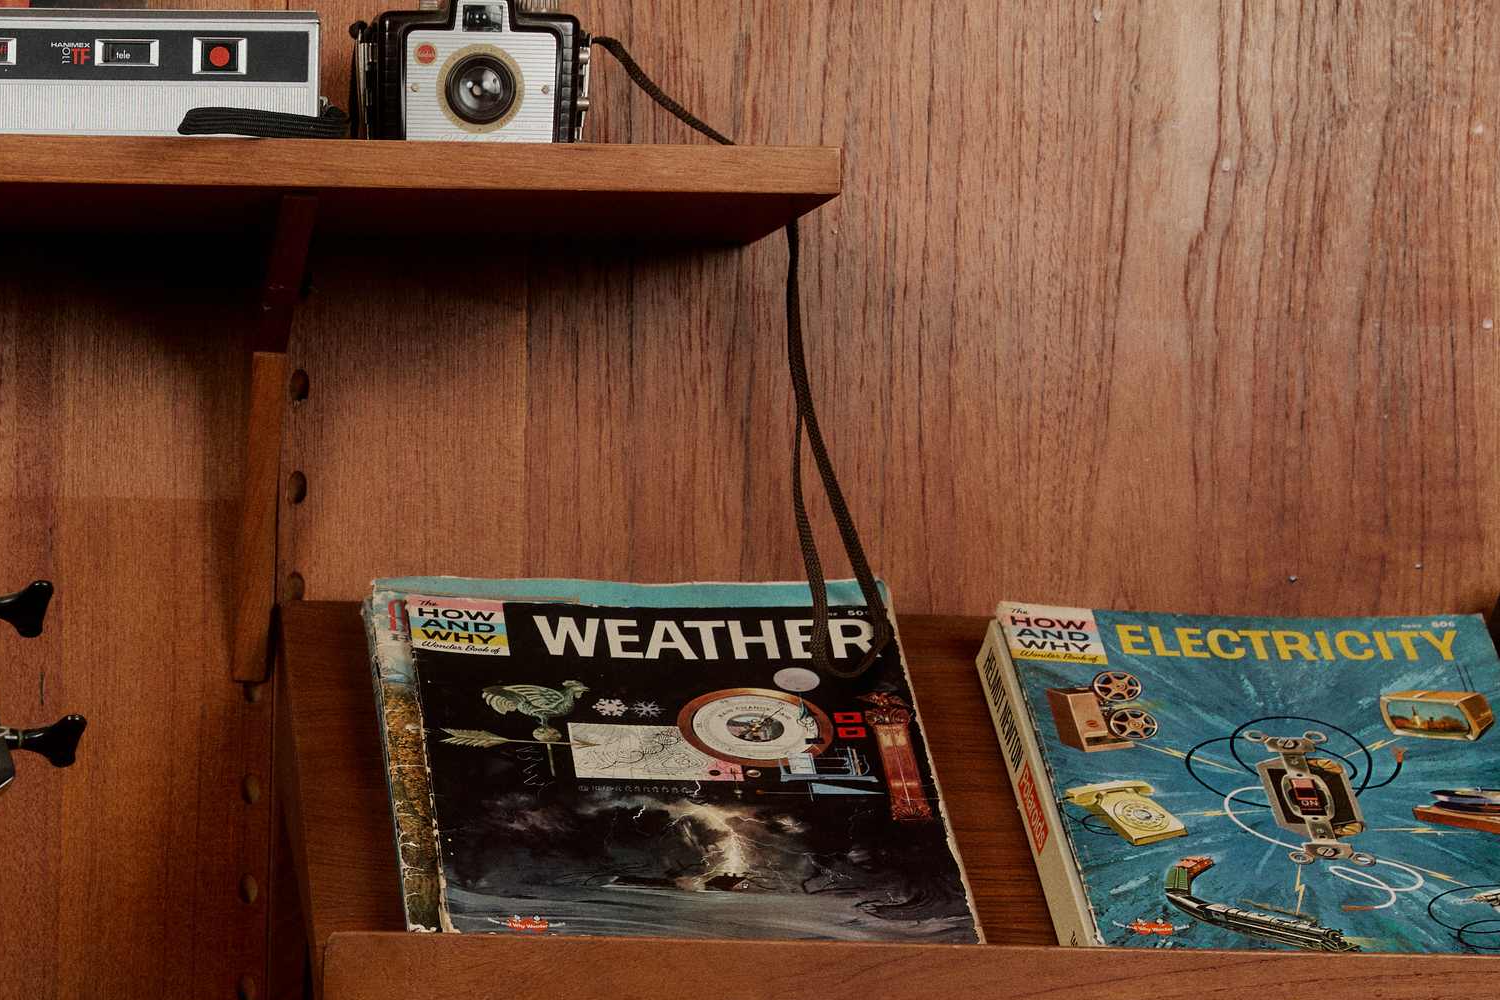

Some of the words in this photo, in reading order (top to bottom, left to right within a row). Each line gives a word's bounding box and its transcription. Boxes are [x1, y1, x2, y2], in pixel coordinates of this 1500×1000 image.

[115, 50, 131, 59] tele
[419, 599, 438, 607] The
[418, 607, 496, 621] HOW
[1011, 607, 1028, 615] The
[420, 618, 496, 633] AND
[1010, 615, 1087, 631] HOW
[420, 629, 497, 645] WHY
[533, 614, 881, 660] WEATHER
[1016, 628, 1090, 642] AND
[421, 640, 463, 651] Wonder
[464, 644, 489, 653] Book
[1017, 638, 1092, 653] WHY
[1115, 623, 1457, 662] ELECTRICITY
[1019, 650, 1060, 660] Wonder
[1063, 653, 1085, 661] Book
[983, 648, 1006, 713] HELMUT
[999, 700, 1024, 773] NEWTON
[1020, 767, 1046, 849] Polaroids
[1300, 799, 1318, 807] ON
